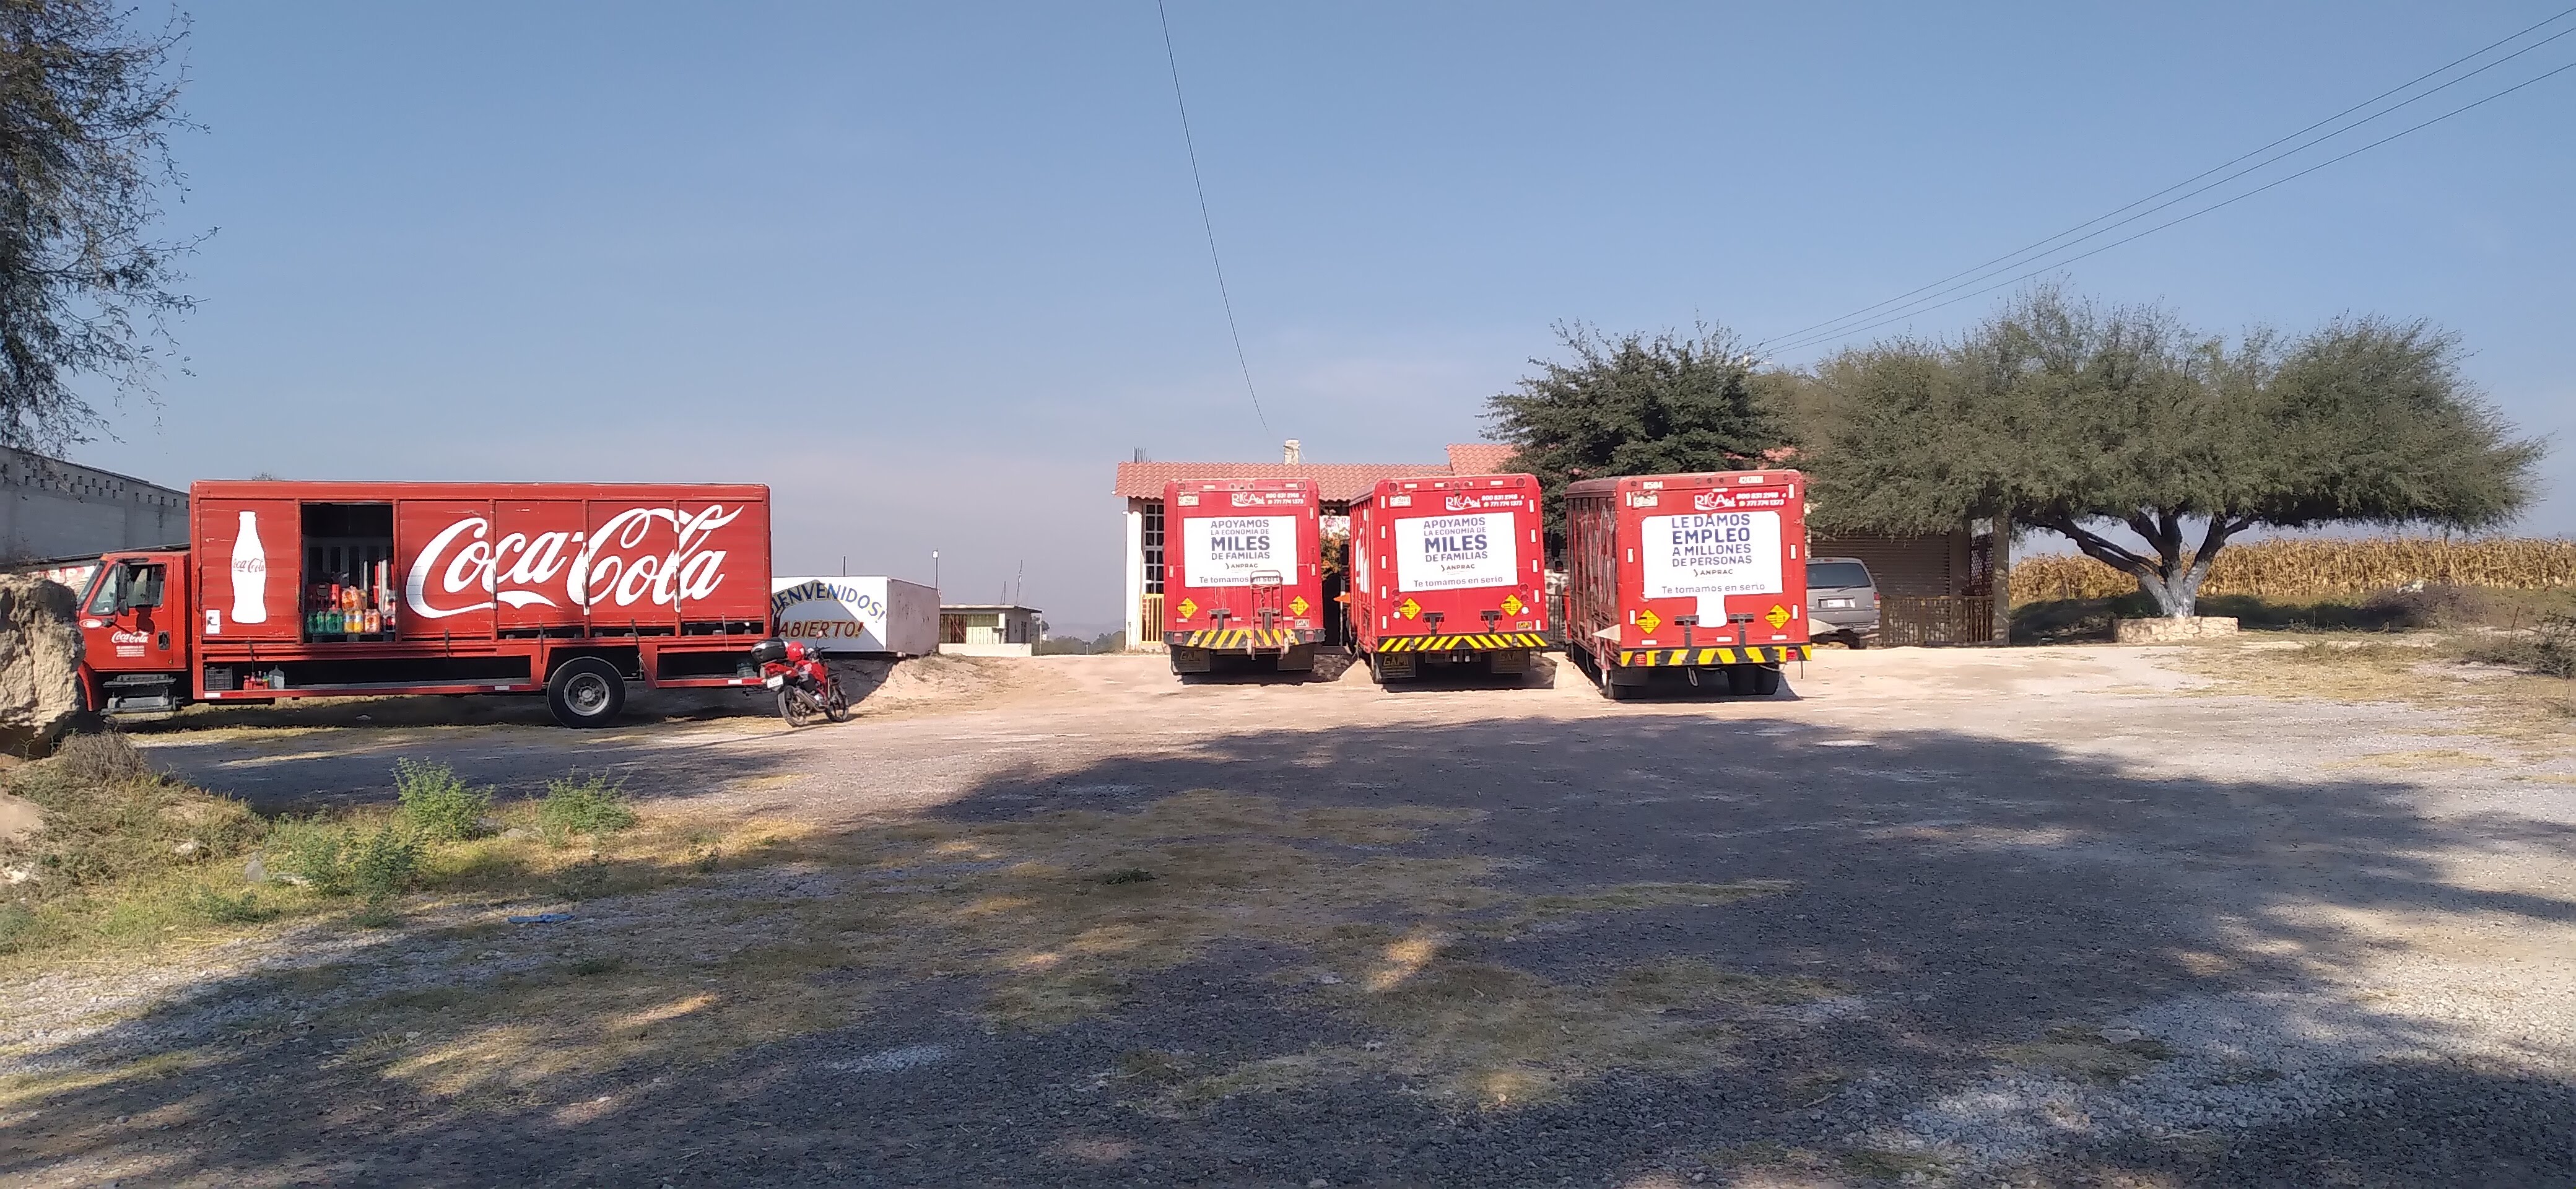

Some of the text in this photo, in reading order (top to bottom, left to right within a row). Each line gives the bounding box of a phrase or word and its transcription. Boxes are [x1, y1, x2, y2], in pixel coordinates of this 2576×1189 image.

[1211, 520, 1269, 528] APOYAMOS
[1424, 517, 1486, 529] APOYAMOS
[1672, 514, 1750, 528] LE DAMOS
[1673, 528, 1750, 544] EMPLEO
[1211, 536, 1270, 551] MILES
[1425, 534, 1487, 553] MILES
[1226, 552, 1270, 560] FAMILIAS
[1441, 551, 1487, 561] FAMILIAS
[1673, 544, 1751, 556] A MILLONES
[1673, 555, 1752, 567] DE PERSONAS
[1425, 578, 1466, 586] tomamos
[1662, 586, 1673, 594] Te
[1675, 585, 1723, 593] tomamos
[1739, 583, 1765, 591] serio
[772, 583, 886, 624] IENVENIDOS!
[777, 621, 864, 638] ABIERTO!
